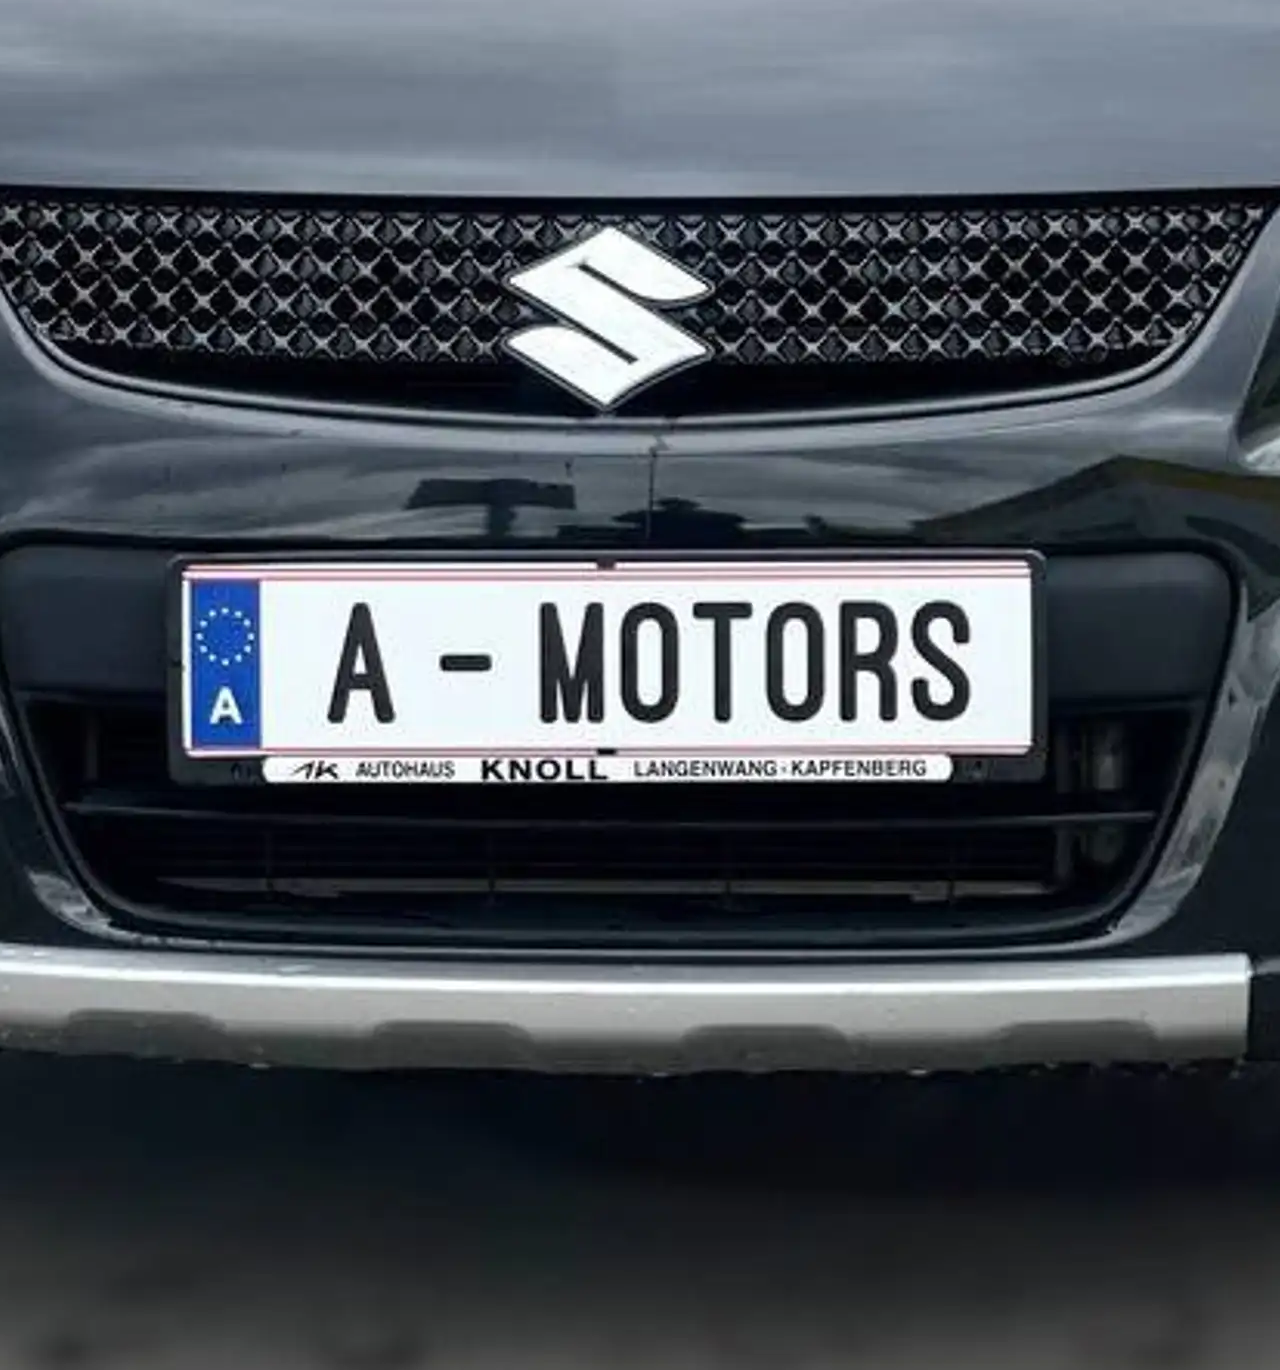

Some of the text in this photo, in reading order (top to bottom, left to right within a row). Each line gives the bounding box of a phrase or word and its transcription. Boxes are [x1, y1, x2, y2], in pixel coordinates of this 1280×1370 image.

[327, 602, 395, 724] A
[539, 601, 970, 724] MOTORS
[210, 687, 242, 724] A
[355, 761, 456, 779] AUTOHAUS
[481, 759, 609, 781] KNOLL
